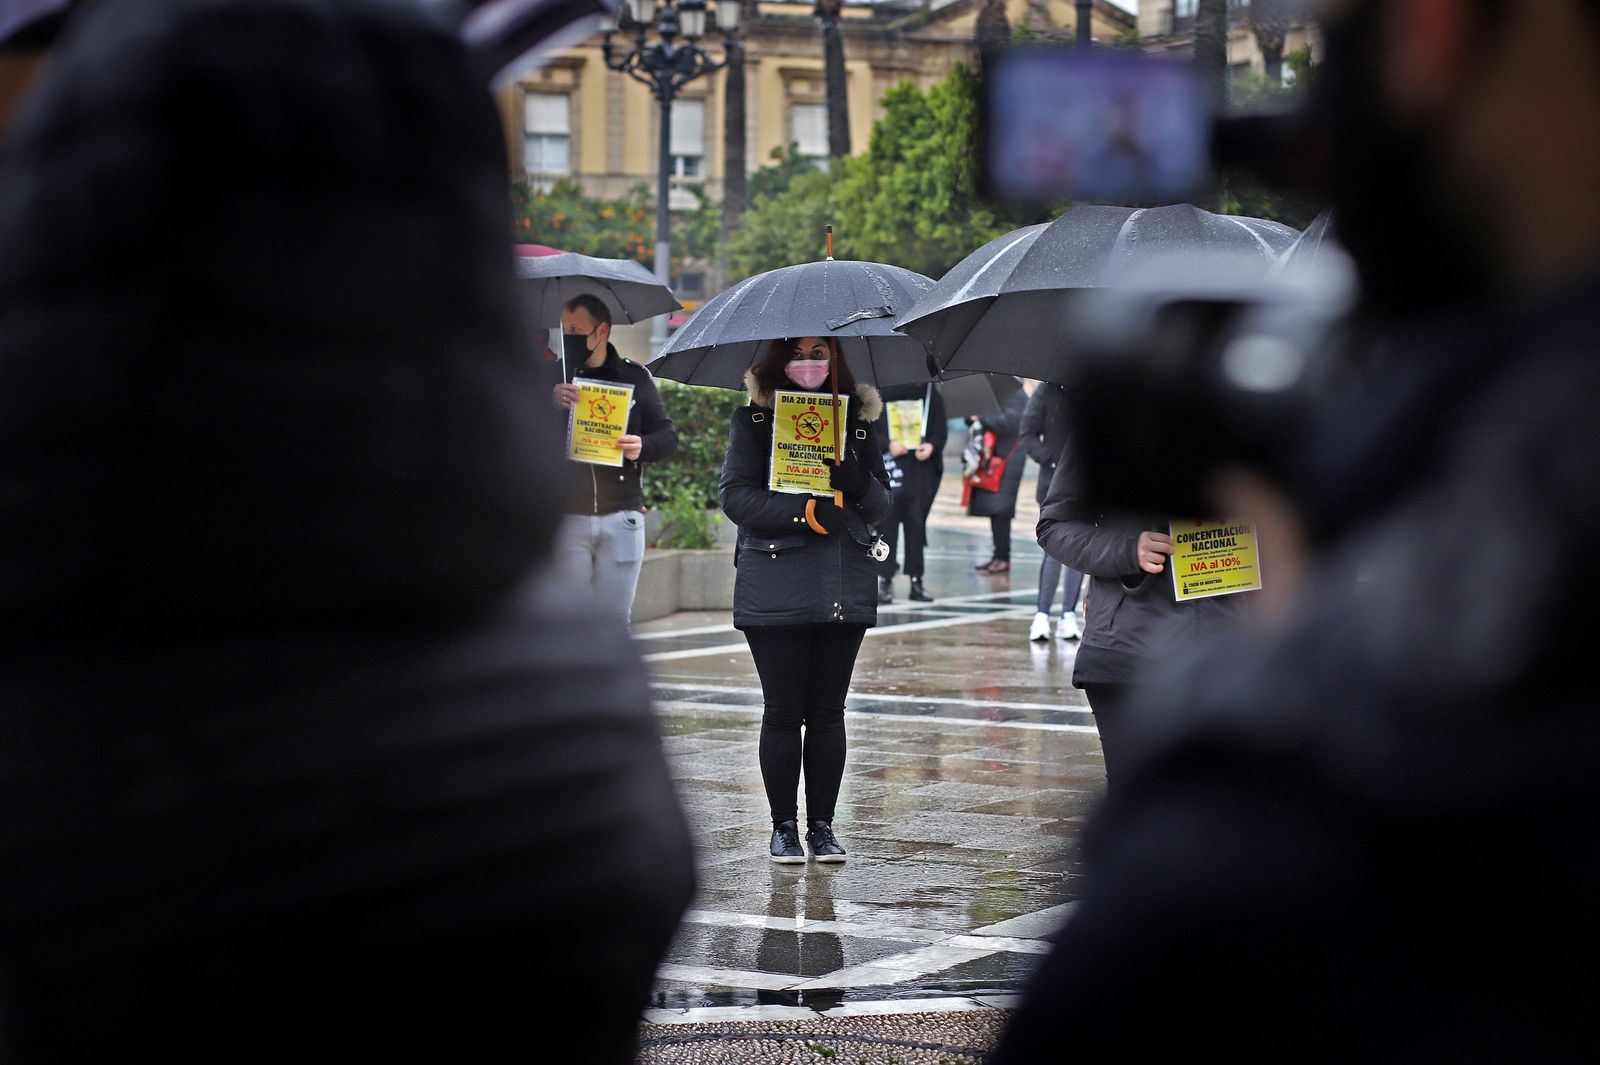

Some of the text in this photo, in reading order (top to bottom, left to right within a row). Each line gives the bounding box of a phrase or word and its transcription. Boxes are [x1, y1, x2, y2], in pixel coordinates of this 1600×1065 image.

[782, 395, 842, 407] DIA 20 DE ENEO
[584, 426, 612, 436] NACIONAL
[778, 442, 834, 454] CONCENTRACIÓ
[789, 452, 826, 460] NACIONAL
[786, 464, 800, 473] IVA
[812, 467, 828, 476] 10%
[1177, 525, 1250, 544] CONCENTRACIÓN
[1192, 537, 1237, 552] NACIONAL
[1190, 556, 1241, 572] IVA al 10%
